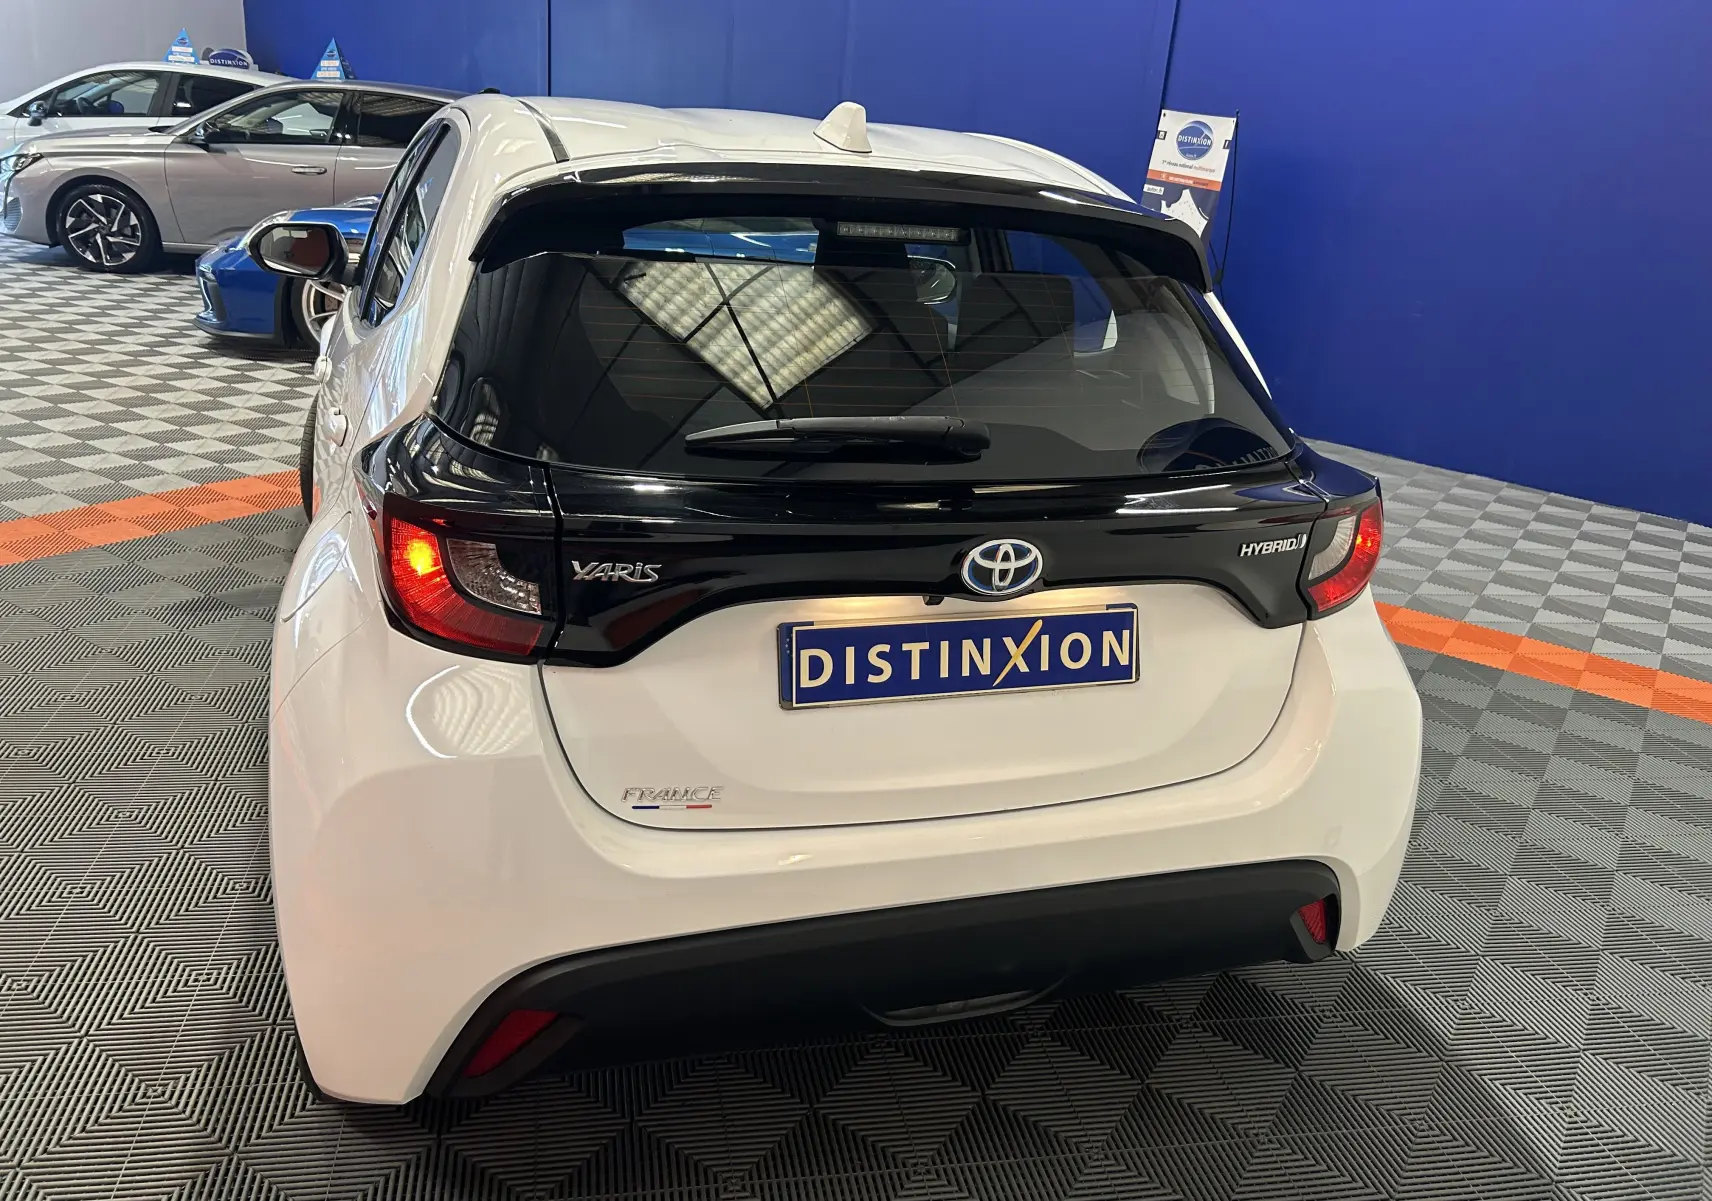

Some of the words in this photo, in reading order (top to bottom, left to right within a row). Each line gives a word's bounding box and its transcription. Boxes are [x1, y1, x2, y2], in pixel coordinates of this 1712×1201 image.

[210, 58, 248, 67] DISTINXION
[1177, 134, 1212, 147] DISTINXION
[1240, 537, 1297, 557] HYBRID
[799, 619, 1130, 688] DISTINXION
[621, 786, 725, 802] FRANCE
